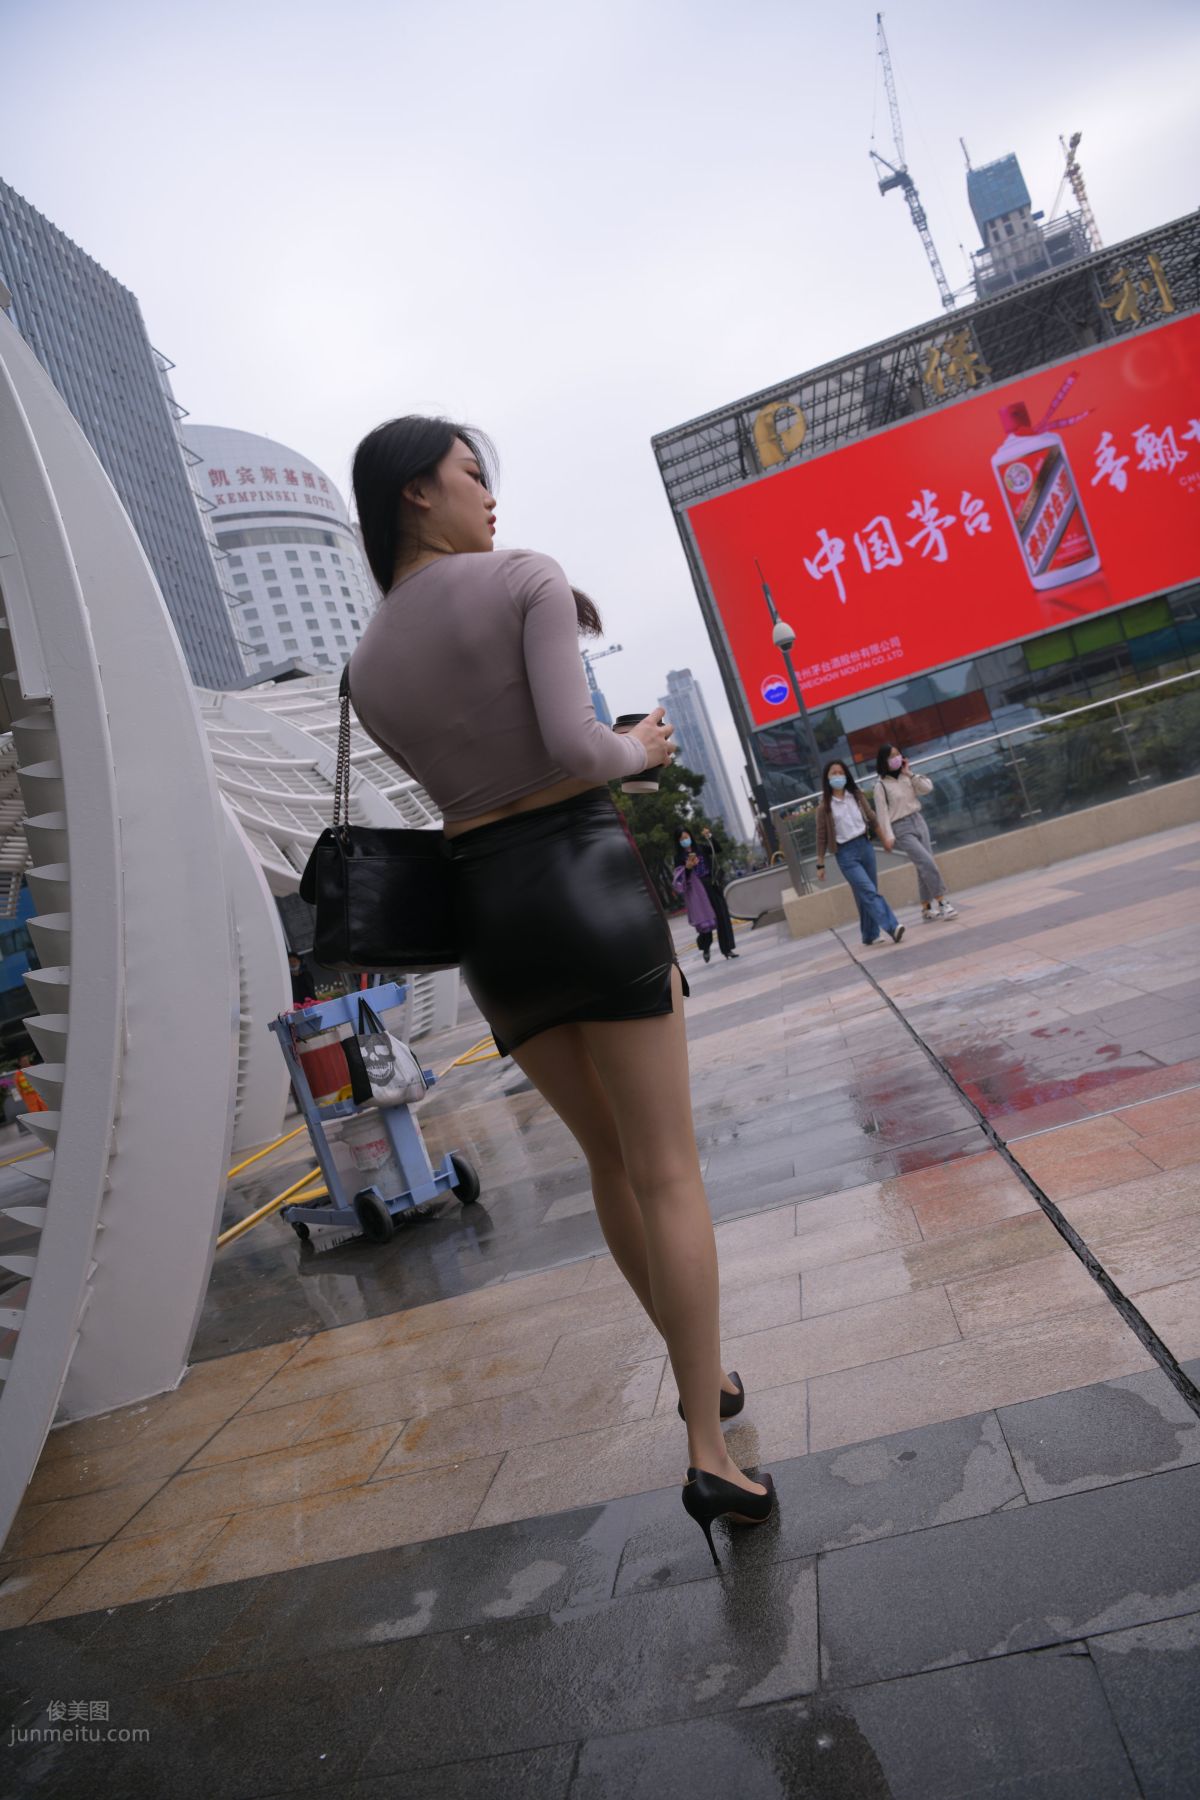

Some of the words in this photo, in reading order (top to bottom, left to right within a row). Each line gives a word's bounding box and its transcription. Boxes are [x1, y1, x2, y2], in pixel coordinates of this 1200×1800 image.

[208, 466, 331, 494] 凯宾斯基酒店
[216, 490, 298, 505] KEMPINSKI
[304, 493, 336, 511] HOTEL
[803, 489, 992, 605] 中国茅台
